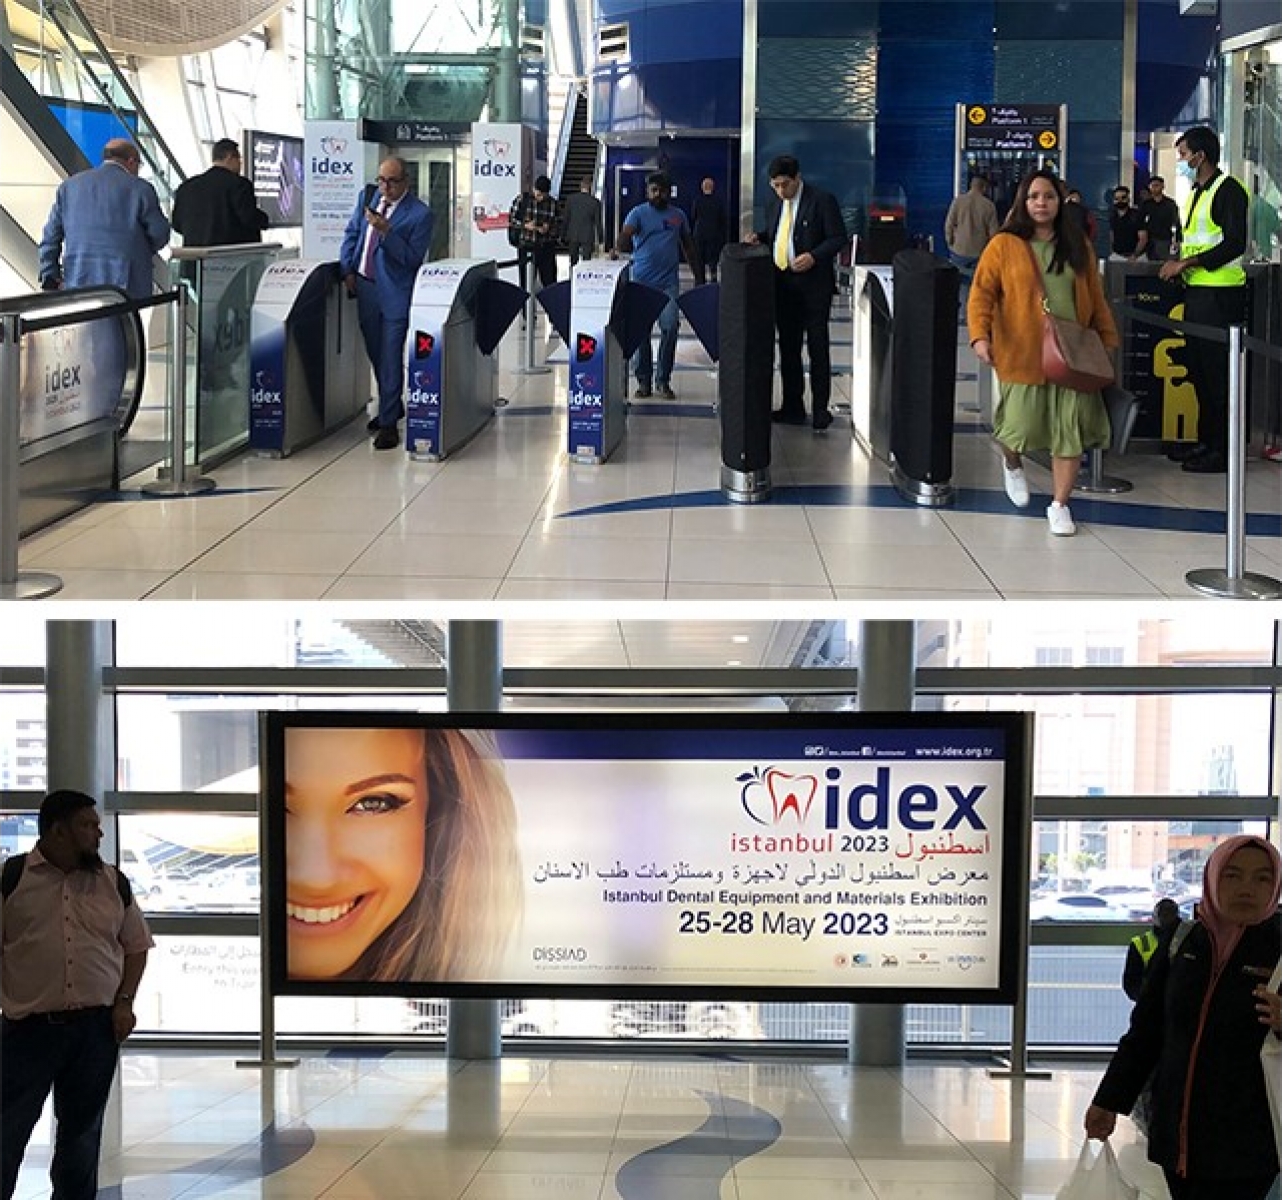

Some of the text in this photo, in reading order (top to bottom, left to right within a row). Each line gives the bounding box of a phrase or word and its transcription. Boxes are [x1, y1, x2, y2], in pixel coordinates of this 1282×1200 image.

[311, 157, 353, 175] idex
[474, 160, 515, 177] idex
[45, 363, 81, 393] idex
[251, 388, 281, 404] idex
[407, 388, 438, 404] idex
[569, 390, 602, 407] idex
[915, 747, 993, 758] www.idex.org.tr
[825, 766, 988, 831] idex
[731, 833, 889, 853] istanbul 2023
[895, 833, 990, 861] اسطنبول
[851, 862, 920, 885] اسطنبول
[927, 868, 989, 886] معرض
[603, 889, 988, 906] Istanbul Dental Equipment and Materials Exhibition
[679, 910, 889, 940] 25-28 May 2023
